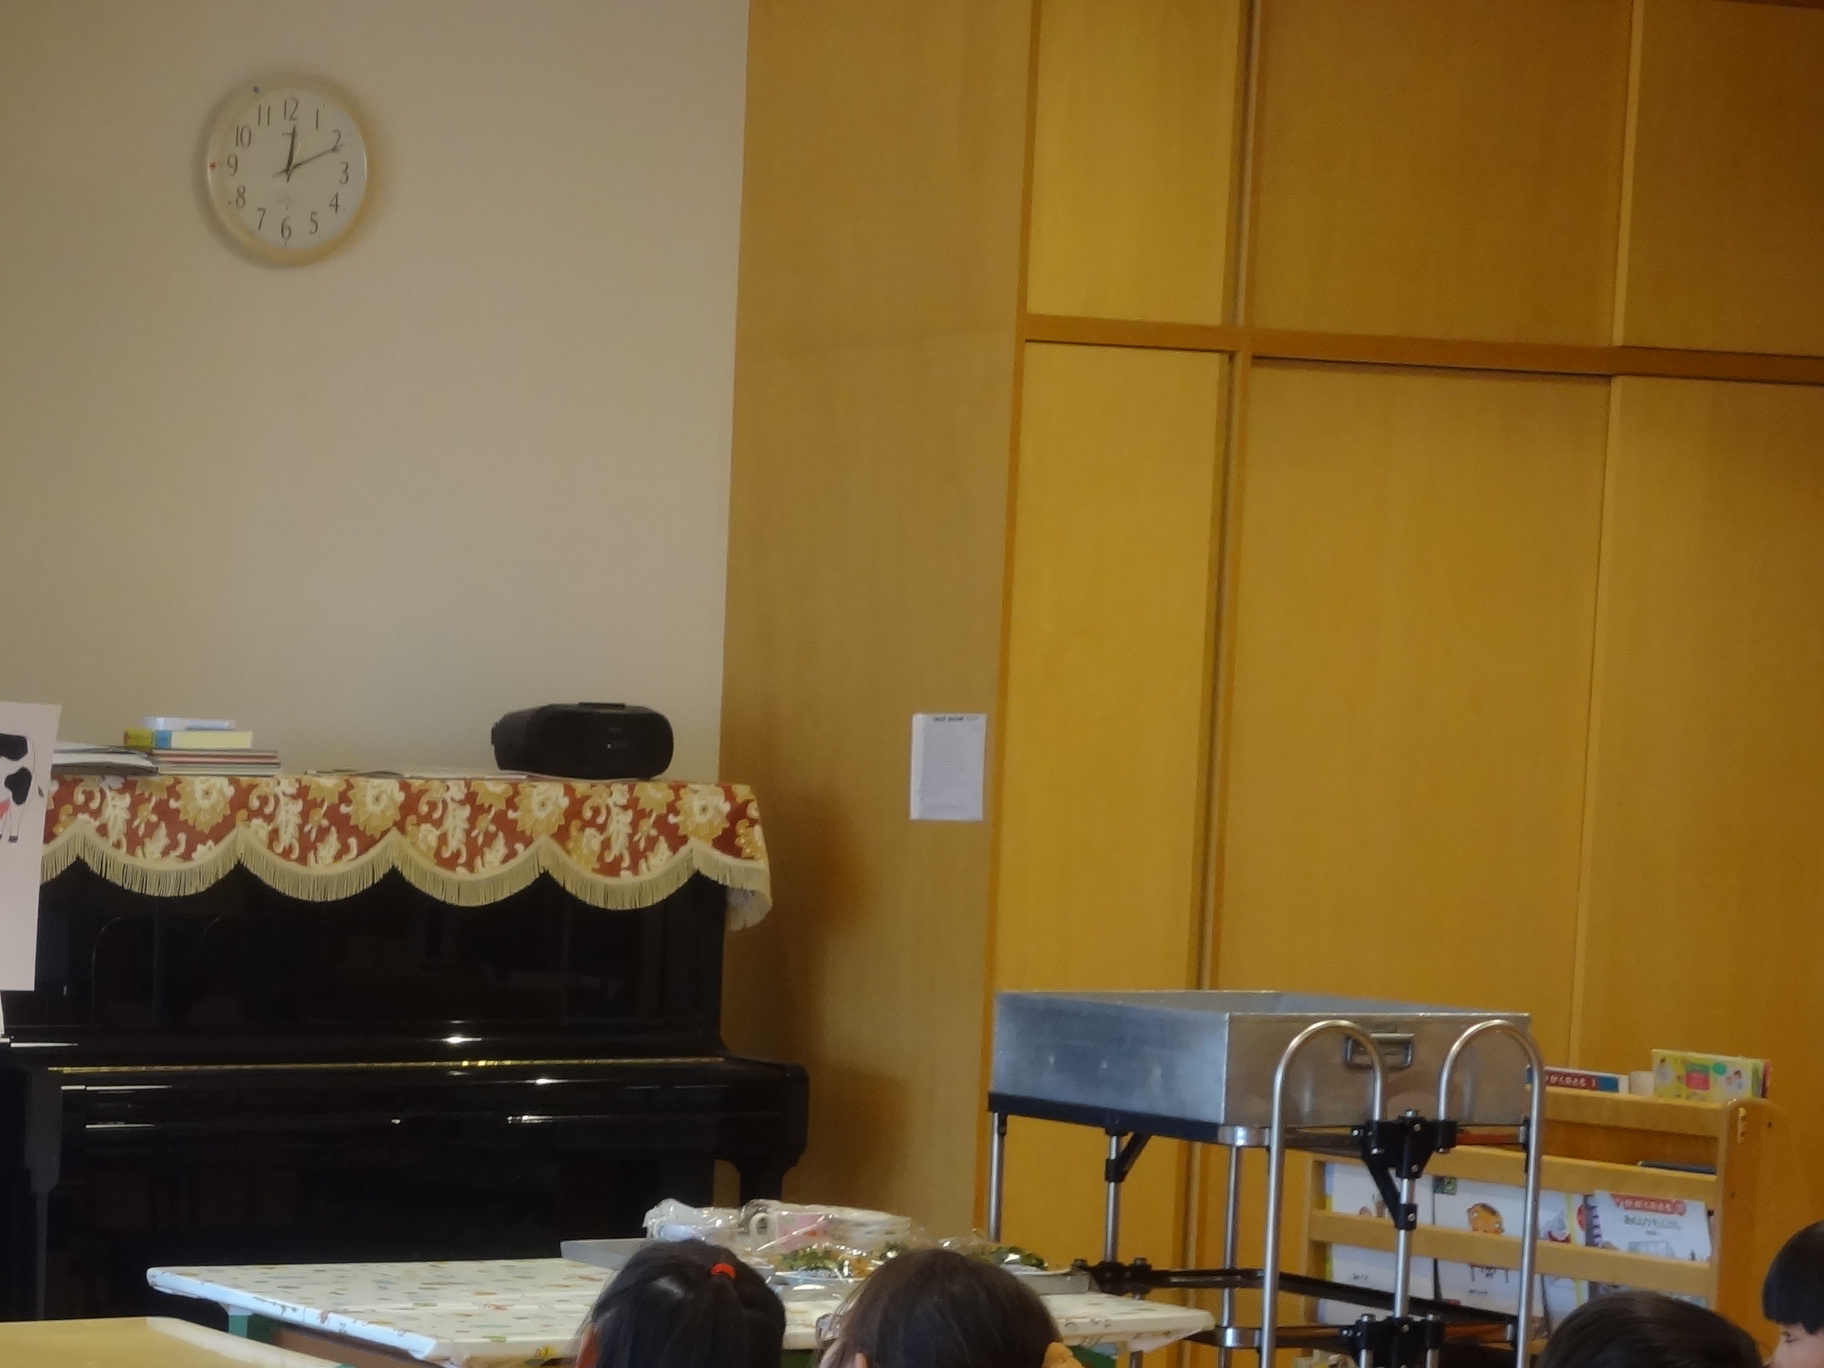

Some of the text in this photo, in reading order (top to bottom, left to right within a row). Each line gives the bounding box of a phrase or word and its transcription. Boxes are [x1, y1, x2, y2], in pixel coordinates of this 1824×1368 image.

[257, 104, 271, 126] 11
[283, 97, 299, 121] 12
[236, 125, 251, 147] 10
[333, 130, 342, 151] 2
[227, 154, 238, 176] 9
[339, 162, 349, 184] 3
[235, 185, 246, 208] 8
[329, 193, 339, 214] 4
[257, 208, 267, 230] 7
[281, 217, 291, 240] 6
[309, 212, 319, 234] 5
